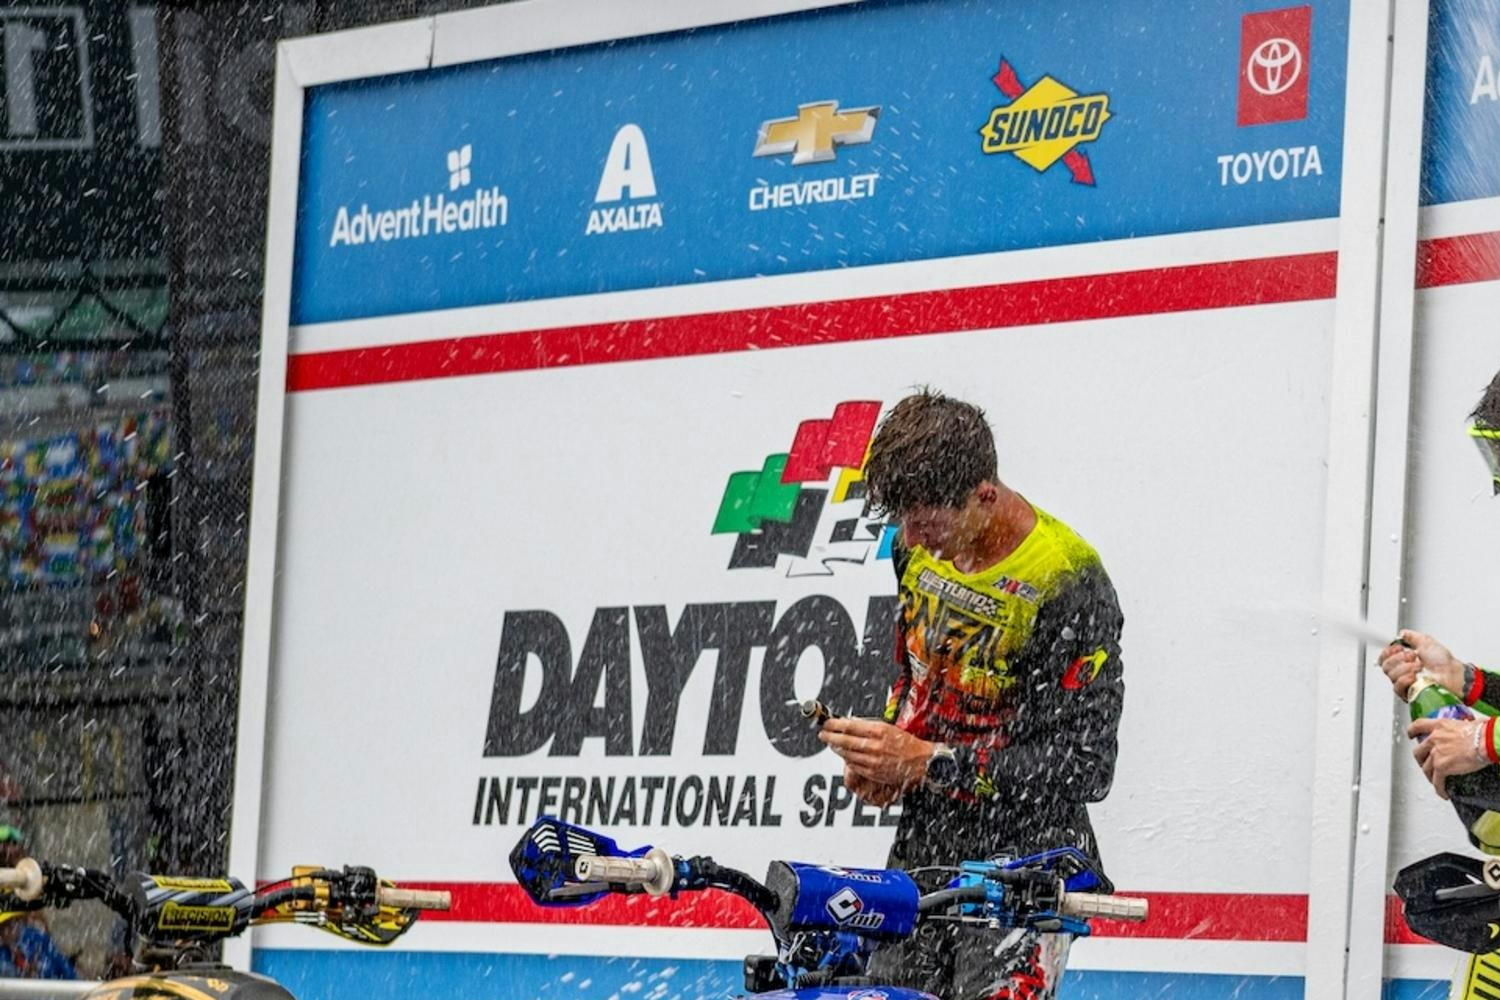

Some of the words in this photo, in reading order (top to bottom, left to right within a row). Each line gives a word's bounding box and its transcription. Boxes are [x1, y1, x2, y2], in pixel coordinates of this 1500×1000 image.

[988, 102, 1102, 148] SUNOCO
[1218, 146, 1323, 186] TOYOTA
[749, 173, 880, 211] CHEVROLET
[330, 186, 508, 247] AdventHealth
[585, 202, 663, 236] AXALTA
[483, 594, 903, 758] DAYTO
[472, 775, 782, 827] INTERNATIONAL
